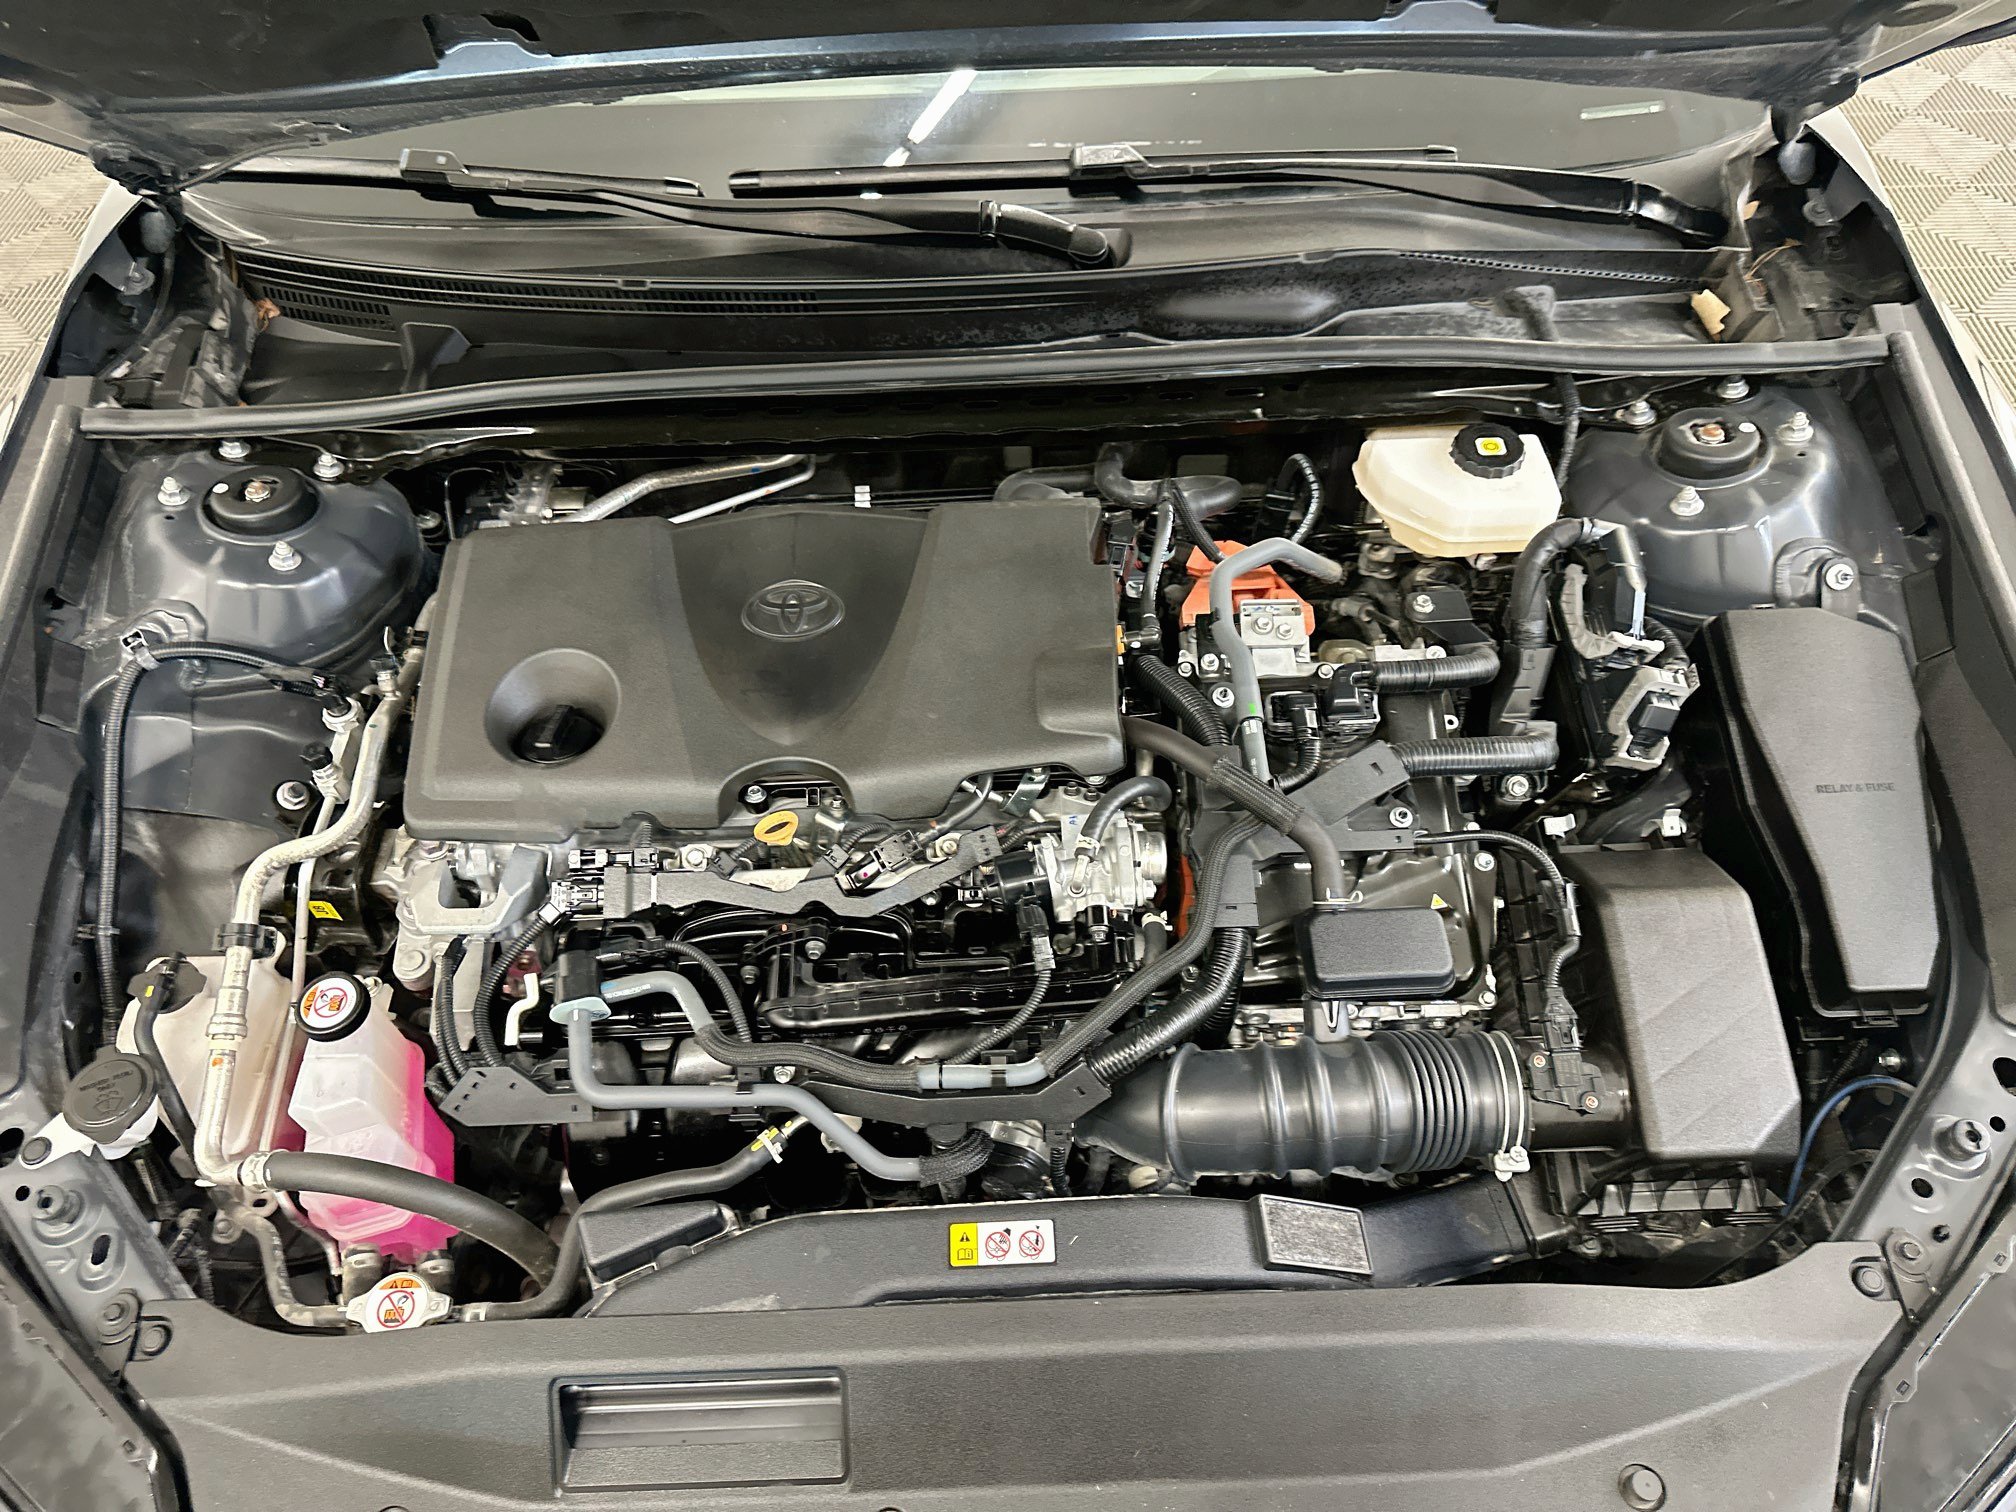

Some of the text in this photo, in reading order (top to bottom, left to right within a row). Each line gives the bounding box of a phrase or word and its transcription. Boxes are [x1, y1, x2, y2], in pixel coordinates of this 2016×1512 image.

[1816, 782, 1895, 793] RELAY & FUSE
